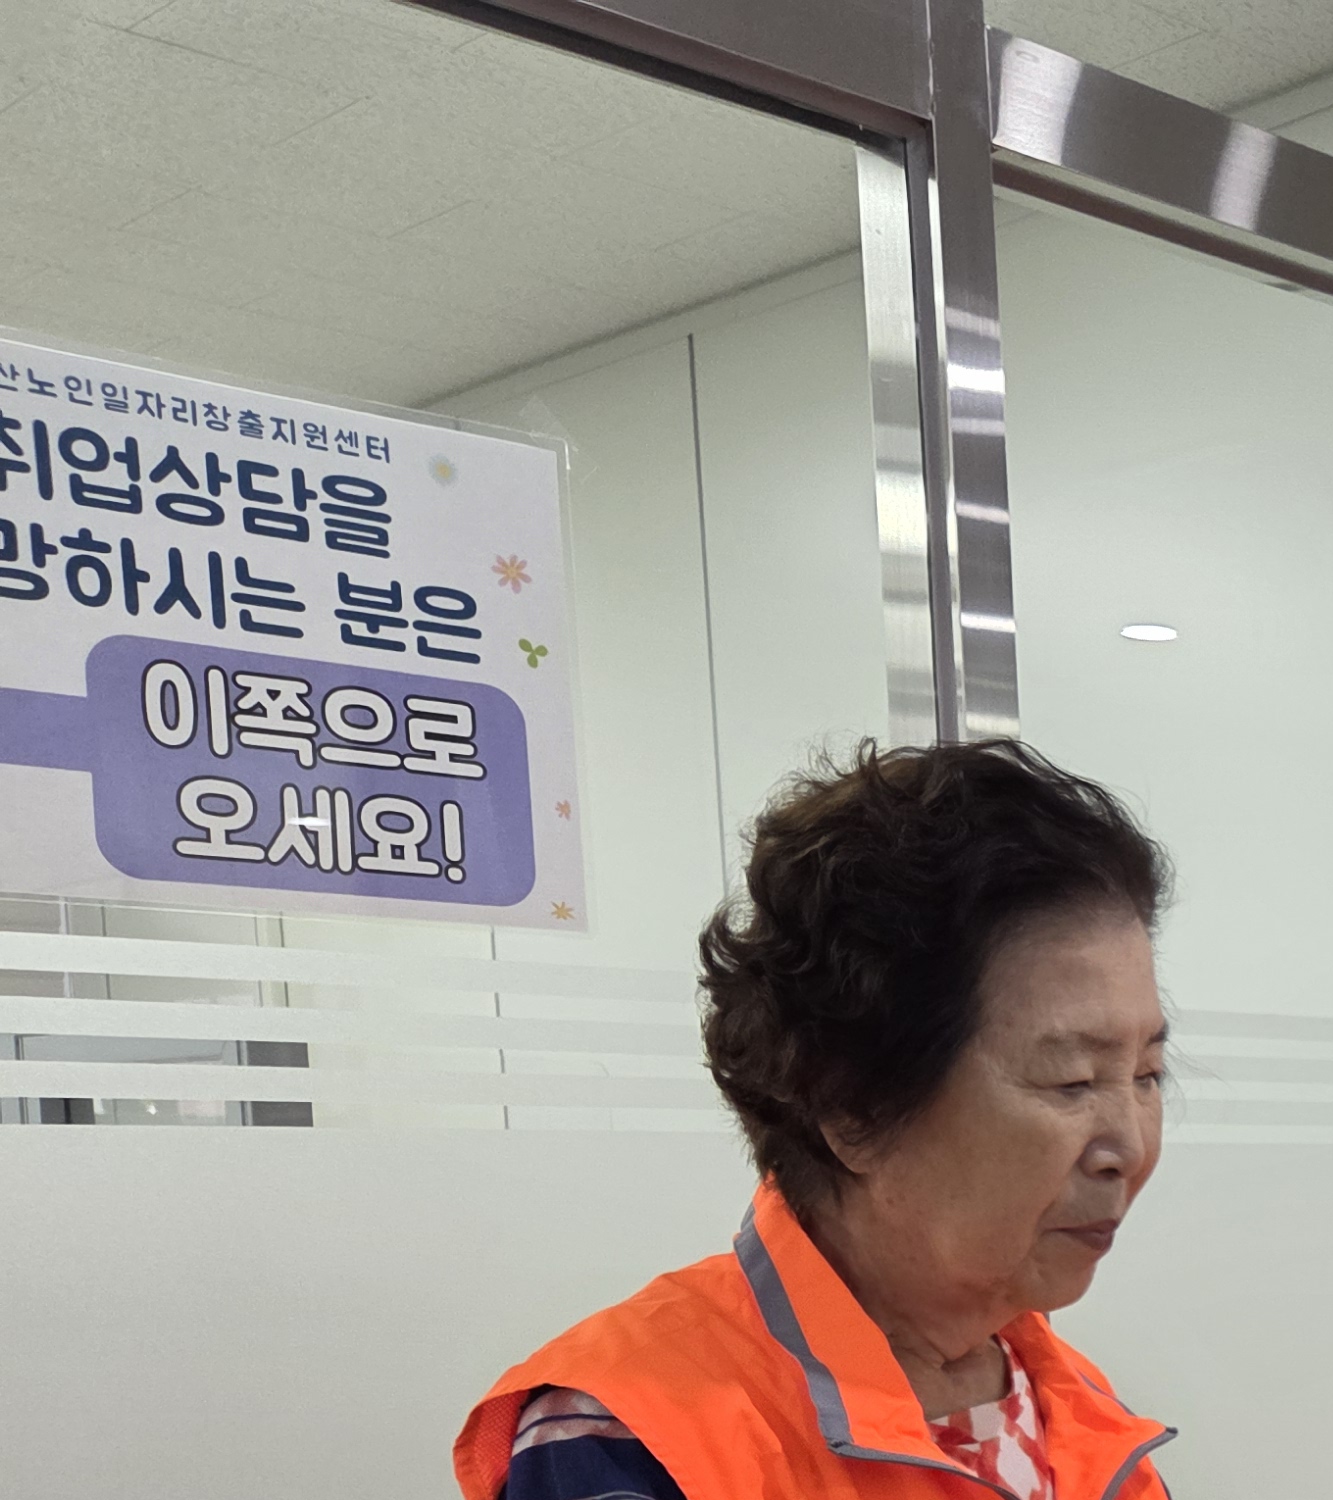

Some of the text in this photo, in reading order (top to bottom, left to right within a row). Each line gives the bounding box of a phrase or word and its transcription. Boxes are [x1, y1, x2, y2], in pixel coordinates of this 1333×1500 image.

[333, 572, 483, 664] 분은
[141, 658, 487, 782] 이쪽으로
[173, 777, 467, 883] 오세요!
